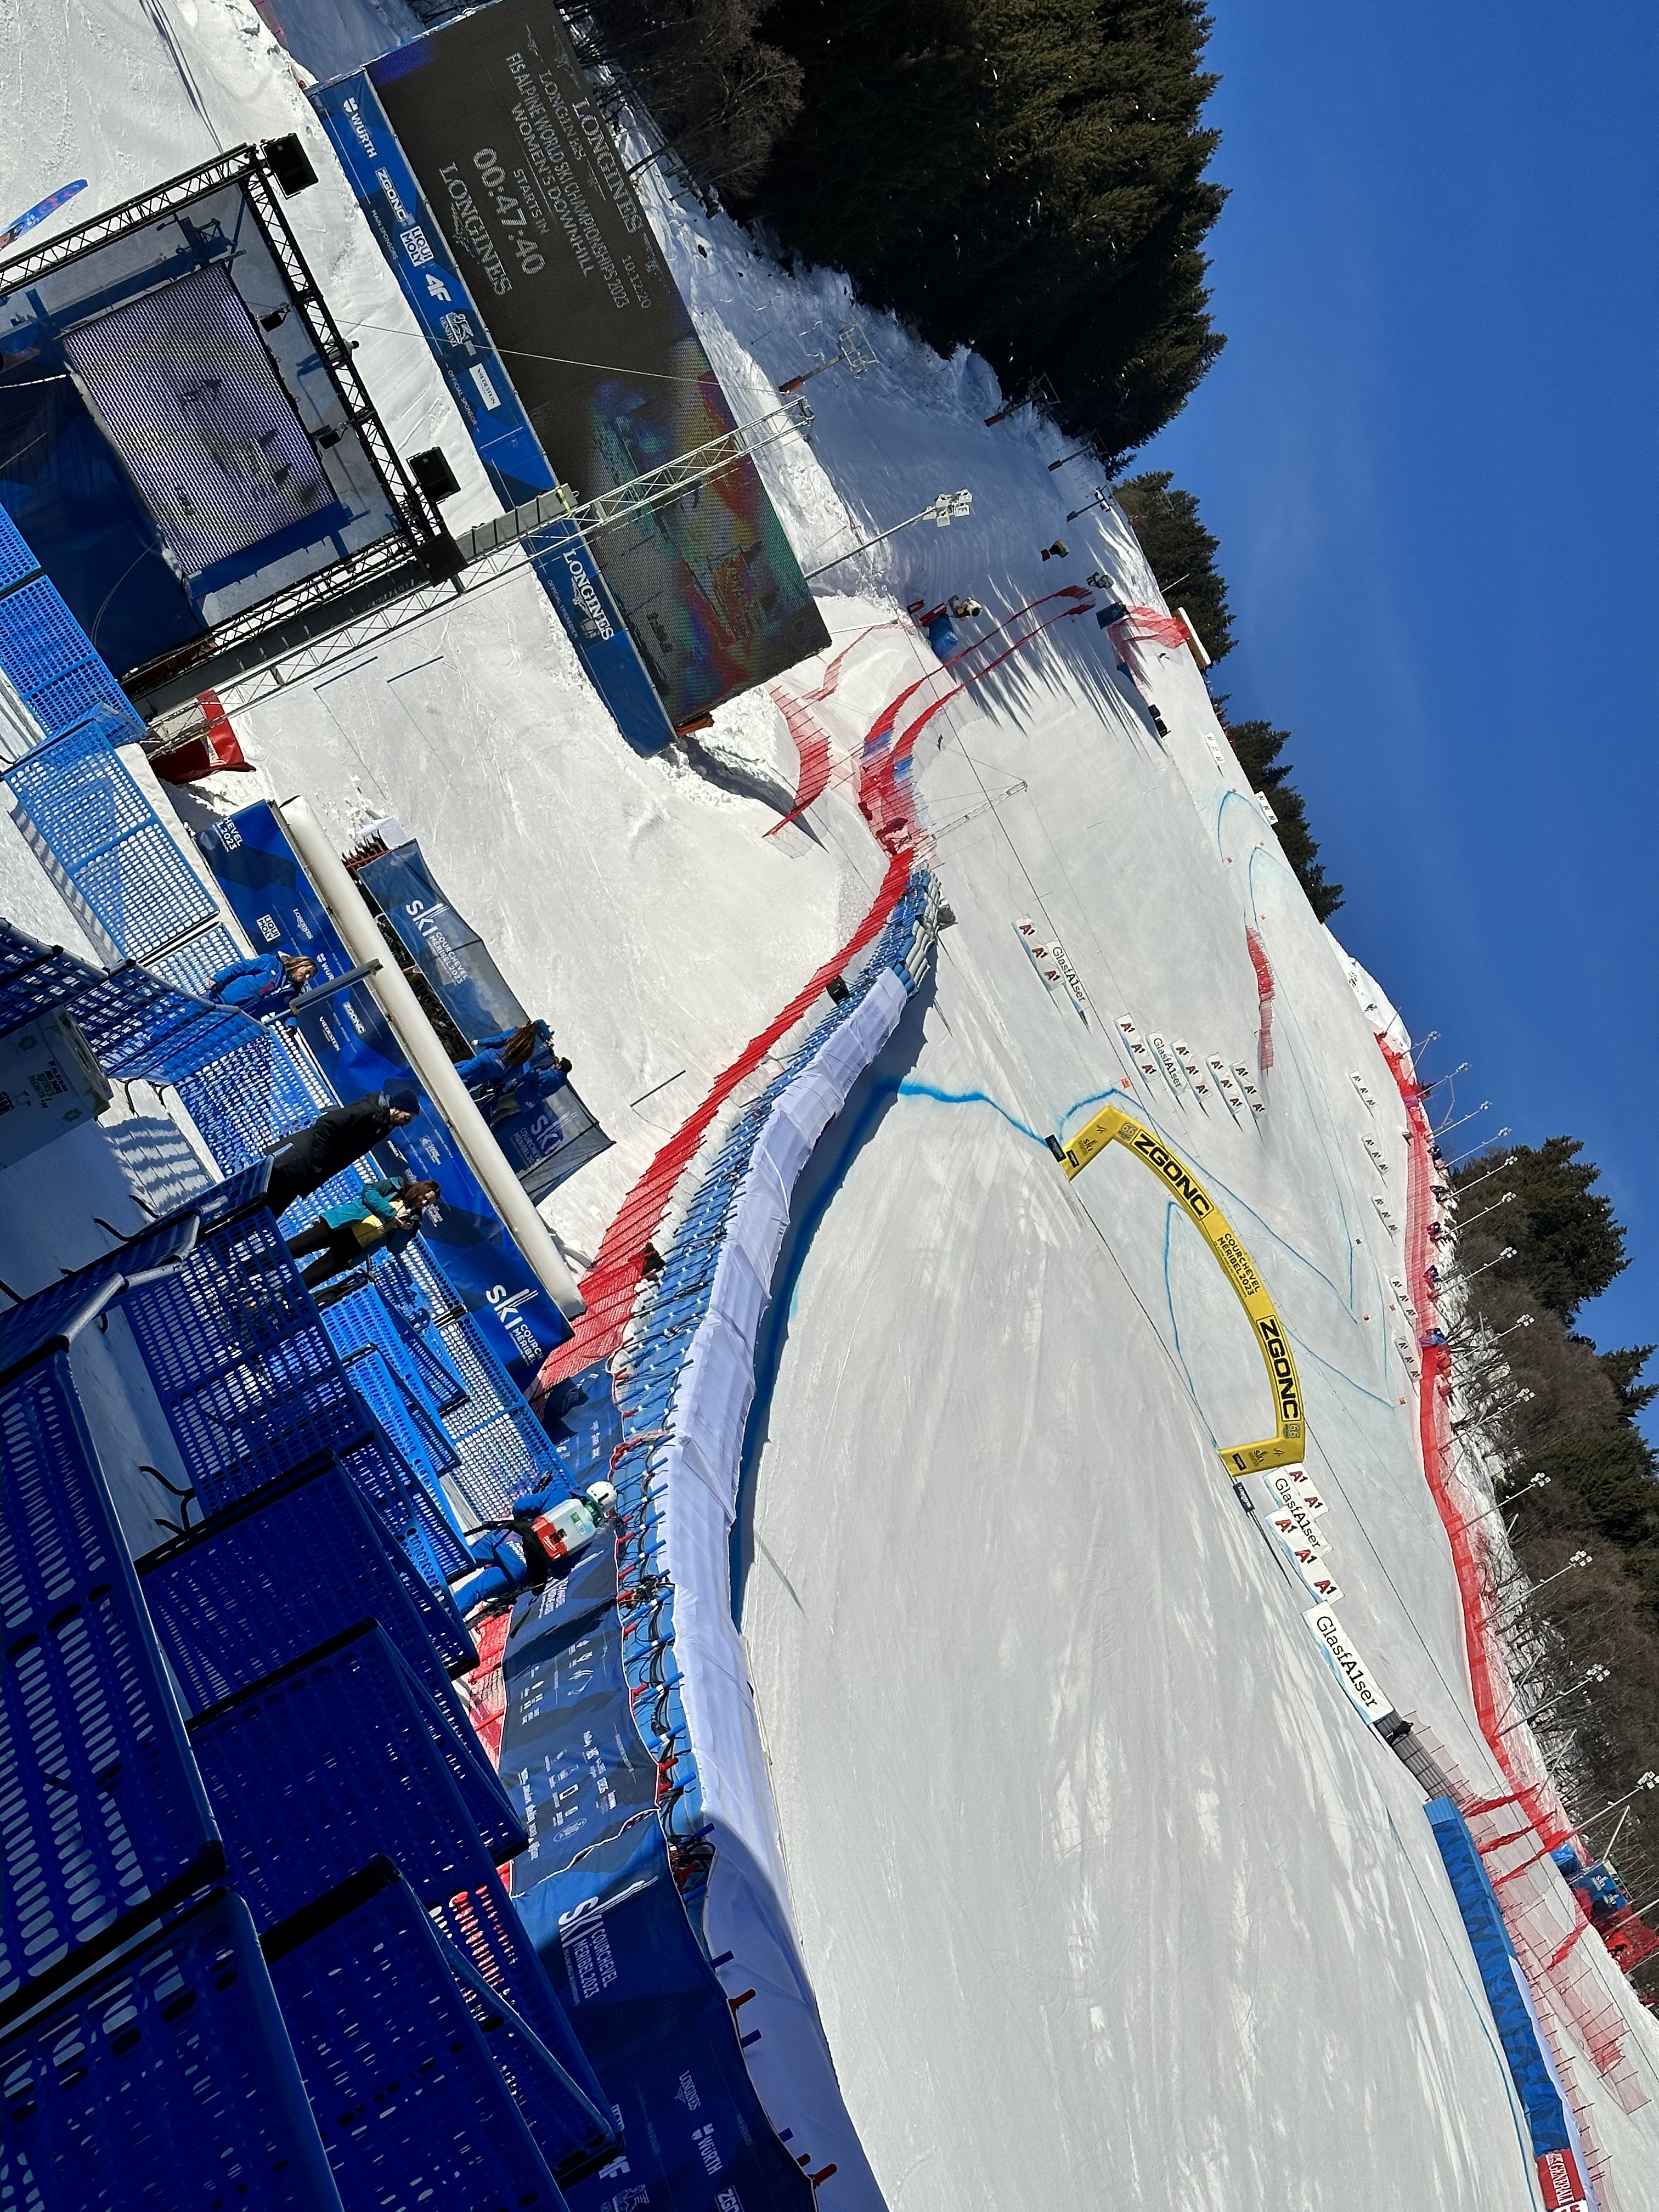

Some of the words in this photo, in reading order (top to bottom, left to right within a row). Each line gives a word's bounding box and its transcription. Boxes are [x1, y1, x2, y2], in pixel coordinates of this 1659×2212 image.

[505, 52, 527, 75] FIS
[512, 70, 547, 119] ALPINE
[536, 69, 590, 161] LONGINES
[532, 114, 568, 165] WORLD
[571, 97, 645, 233] LONGINES
[377, 168, 407, 220] ZGONC
[507, 102, 557, 187] WOMEN'S
[545, 185, 599, 277] DOWNHILL
[553, 160, 575, 184] SKI
[470, 144, 549, 278] 00:47:40
[511, 167, 544, 219] STARTS
[535, 218, 550, 235] IN
[370, 209, 382, 226] MAIN
[378, 225, 398, 259] SPONSORS
[401, 233, 422, 264] MOLY
[410, 228, 432, 260] LIQUI
[437, 161, 514, 297] LONGINES
[561, 181, 620, 281] CHAMPIONSHIPS
[426, 274, 452, 301] 4F
[606, 278, 631, 309] 2023
[619, 254, 654, 309] 10:12:20
[447, 369, 464, 397] OFFICIAL
[460, 397, 477, 426] SPONSOR
[546, 579, 562, 605] OFFICIAL
[558, 604, 579, 639] TIMEKEEPER
[562, 548, 615, 641] LONGINES
[257, 919, 273, 940] MOLY
[263, 916, 279, 937] LIQUI
[435, 931, 469, 981] COURCHEVEL
[1019, 924, 1035, 935] A1
[1031, 947, 1048, 958] A1
[1043, 970, 1060, 981] A1
[344, 1002, 365, 1033] ZGONC
[1120, 1022, 1135, 1032] A1
[1130, 1044, 1144, 1054] A1
[1141, 1064, 1156, 1074] A1
[1175, 1046, 1189, 1056] A1
[1185, 1065, 1199, 1075] A1
[1195, 1085, 1208, 1094] A1
[1210, 1060, 1223, 1070] A1
[1220, 1079, 1233, 1088] A1
[1229, 1098, 1242, 1107] A1
[1235, 1067, 1248, 1076] A1
[1244, 1085, 1257, 1094] A1
[1252, 1103, 1265, 1112] A1
[1134, 1133, 1211, 1217] ZGONC
[1223, 1232, 1261, 1293] COURCHEVEL
[1259, 1318, 1298, 1419] ZGONC
[1289, 1470, 1307, 1483] A1
[1304, 1496, 1323, 1509] A1
[1274, 1518, 1297, 1534] A1
[1294, 1549, 1317, 1564] A1
[1313, 1579, 1336, 1595] A1
[591, 1928, 617, 1988] COURCHEVEL
[679, 2070, 701, 2111] LONGINES
[697, 2136, 722, 2175] WÜRTH
[1549, 2162, 1574, 2205] GENERALI
